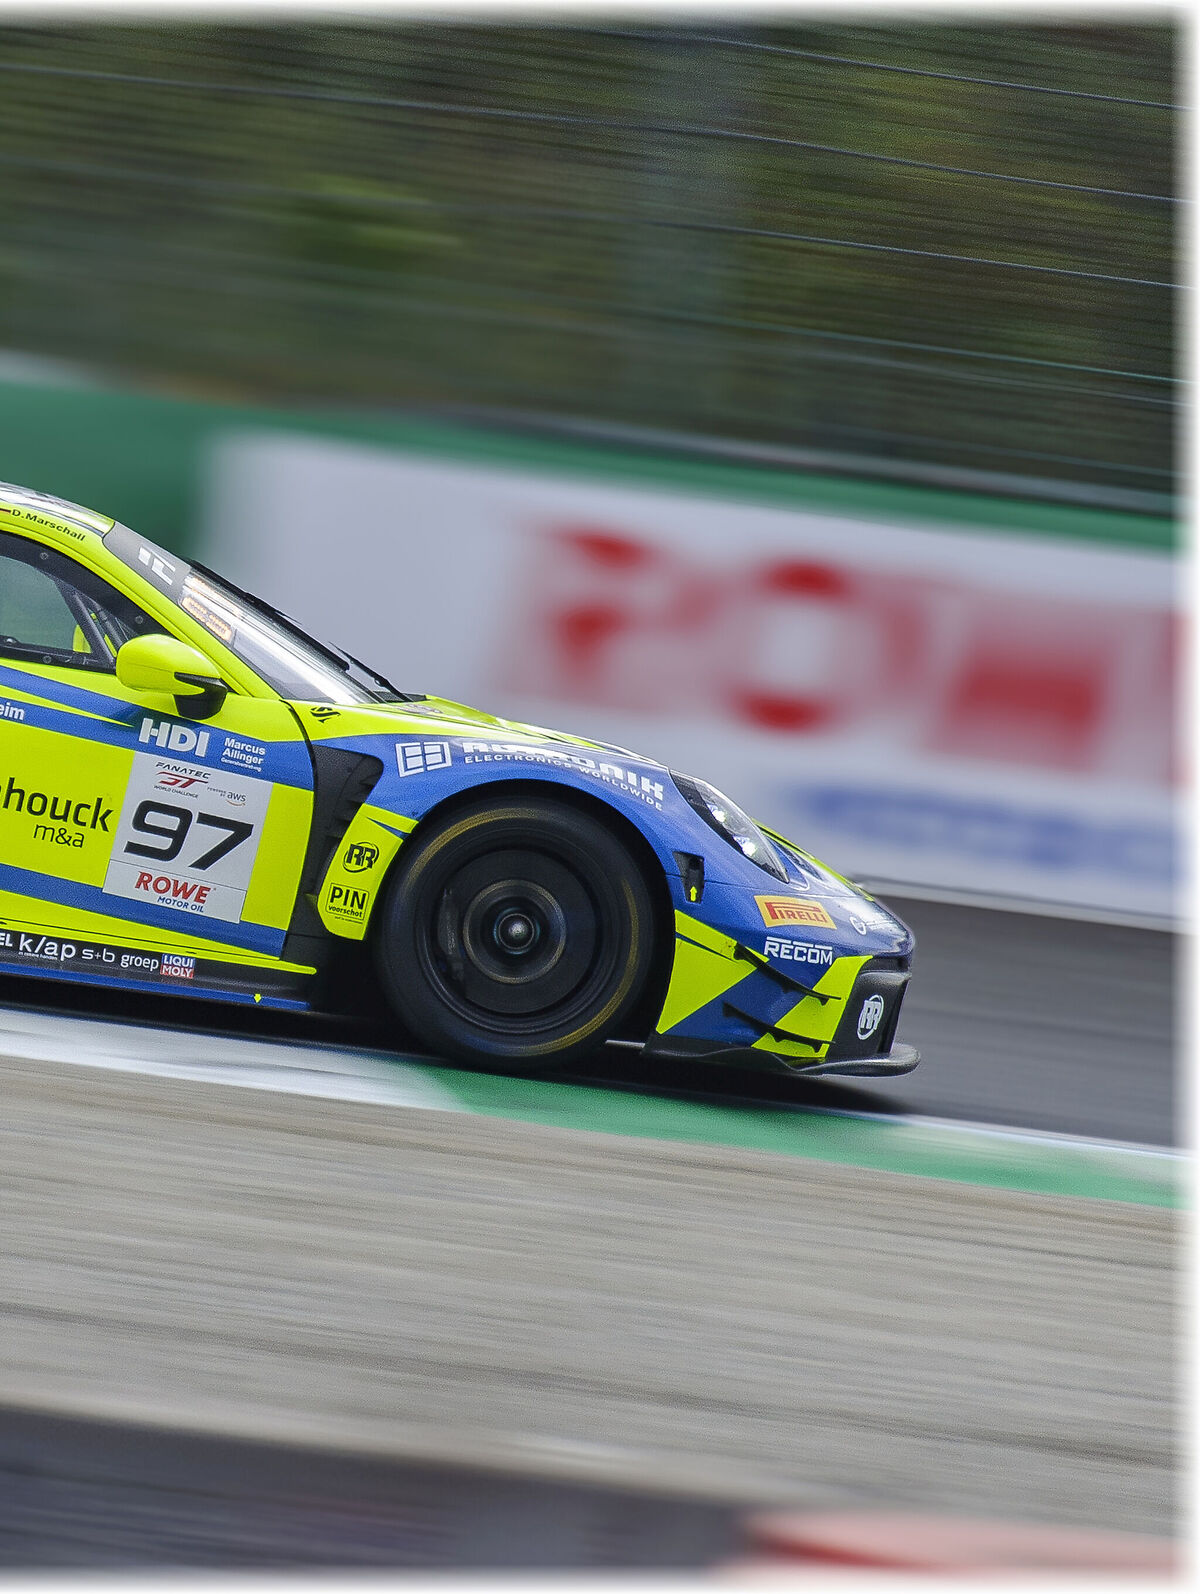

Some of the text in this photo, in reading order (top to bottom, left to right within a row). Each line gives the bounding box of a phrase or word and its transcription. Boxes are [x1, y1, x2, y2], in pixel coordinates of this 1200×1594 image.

[12, 509, 86, 541] D.Marschall
[139, 717, 210, 757] HDI
[224, 737, 266, 755] Marcus
[155, 761, 211, 779] FANATEC
[464, 754, 663, 811] ELECTRONICS WORLDWIDE
[227, 791, 247, 802] aws
[33, 822, 85, 848] m&a
[123, 800, 254, 871] 97
[135, 871, 211, 904] ROWE
[330, 886, 366, 910] PIN
[157, 896, 204, 913] MOTOR OIL
[328, 905, 363, 918] voorschot
[764, 901, 828, 924] PIRELLI
[120, 954, 159, 971] groep
[163, 955, 194, 967] LIQUI
[763, 937, 833, 965] RECOM
[162, 965, 194, 977] MOLY
